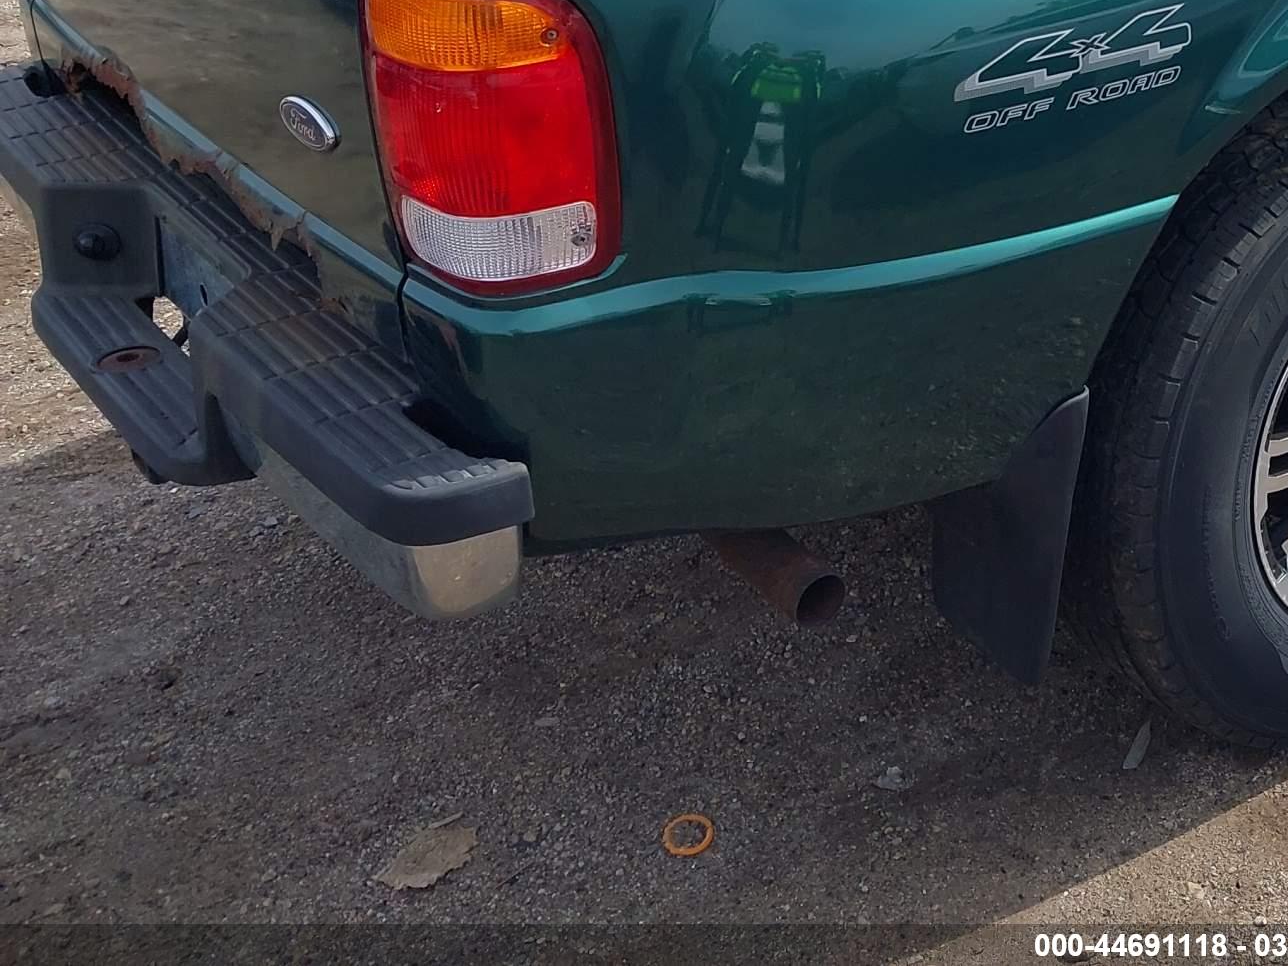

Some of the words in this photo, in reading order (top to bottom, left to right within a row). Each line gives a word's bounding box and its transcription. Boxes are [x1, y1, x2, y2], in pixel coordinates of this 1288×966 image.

[289, 108, 316, 141] Ford
[963, 97, 1055, 134] OFF
[1065, 65, 1182, 111] ROAD
